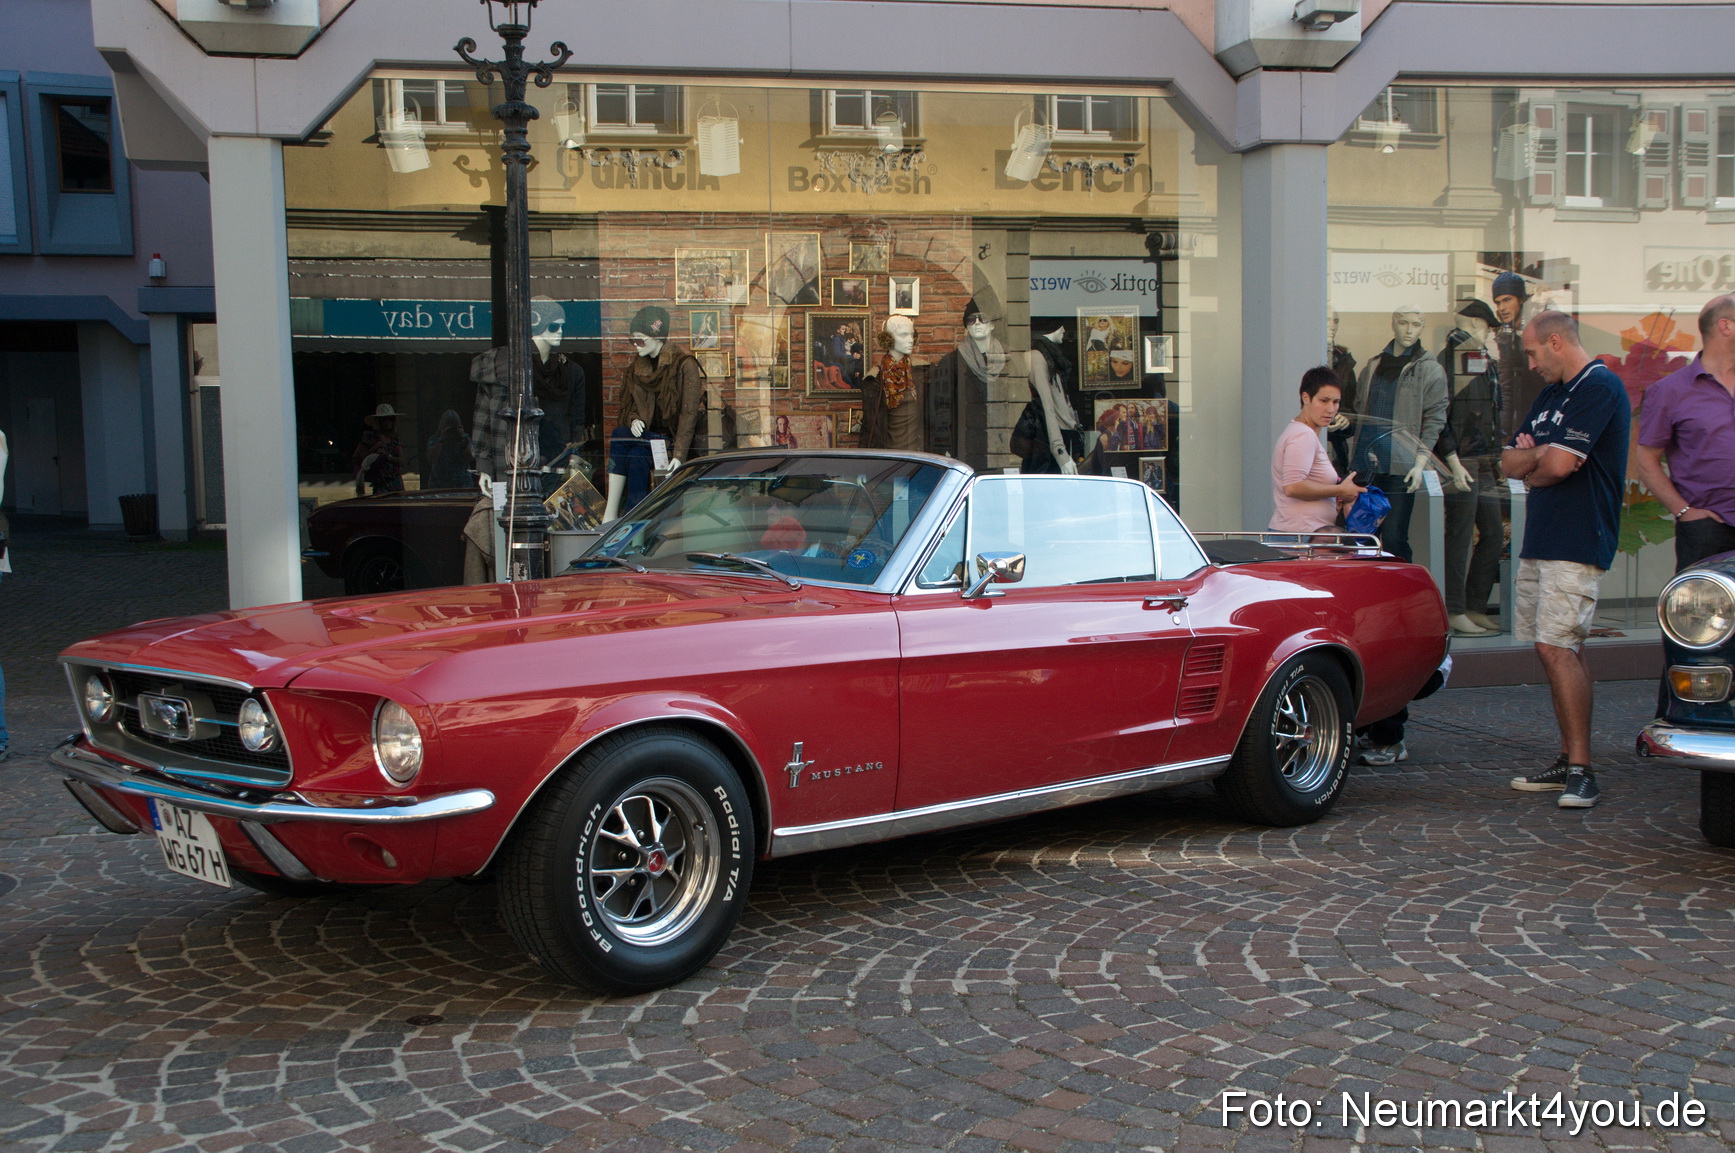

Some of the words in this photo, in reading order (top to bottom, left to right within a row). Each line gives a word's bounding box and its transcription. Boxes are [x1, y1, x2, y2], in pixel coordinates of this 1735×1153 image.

[994, 150, 1165, 193] Bench.
[811, 761, 883, 780] MUSTANG
[173, 806, 199, 841] AZ
[713, 785, 741, 859] Radial
[575, 803, 613, 953] BFGoodrich
[722, 867, 740, 901] T/A
